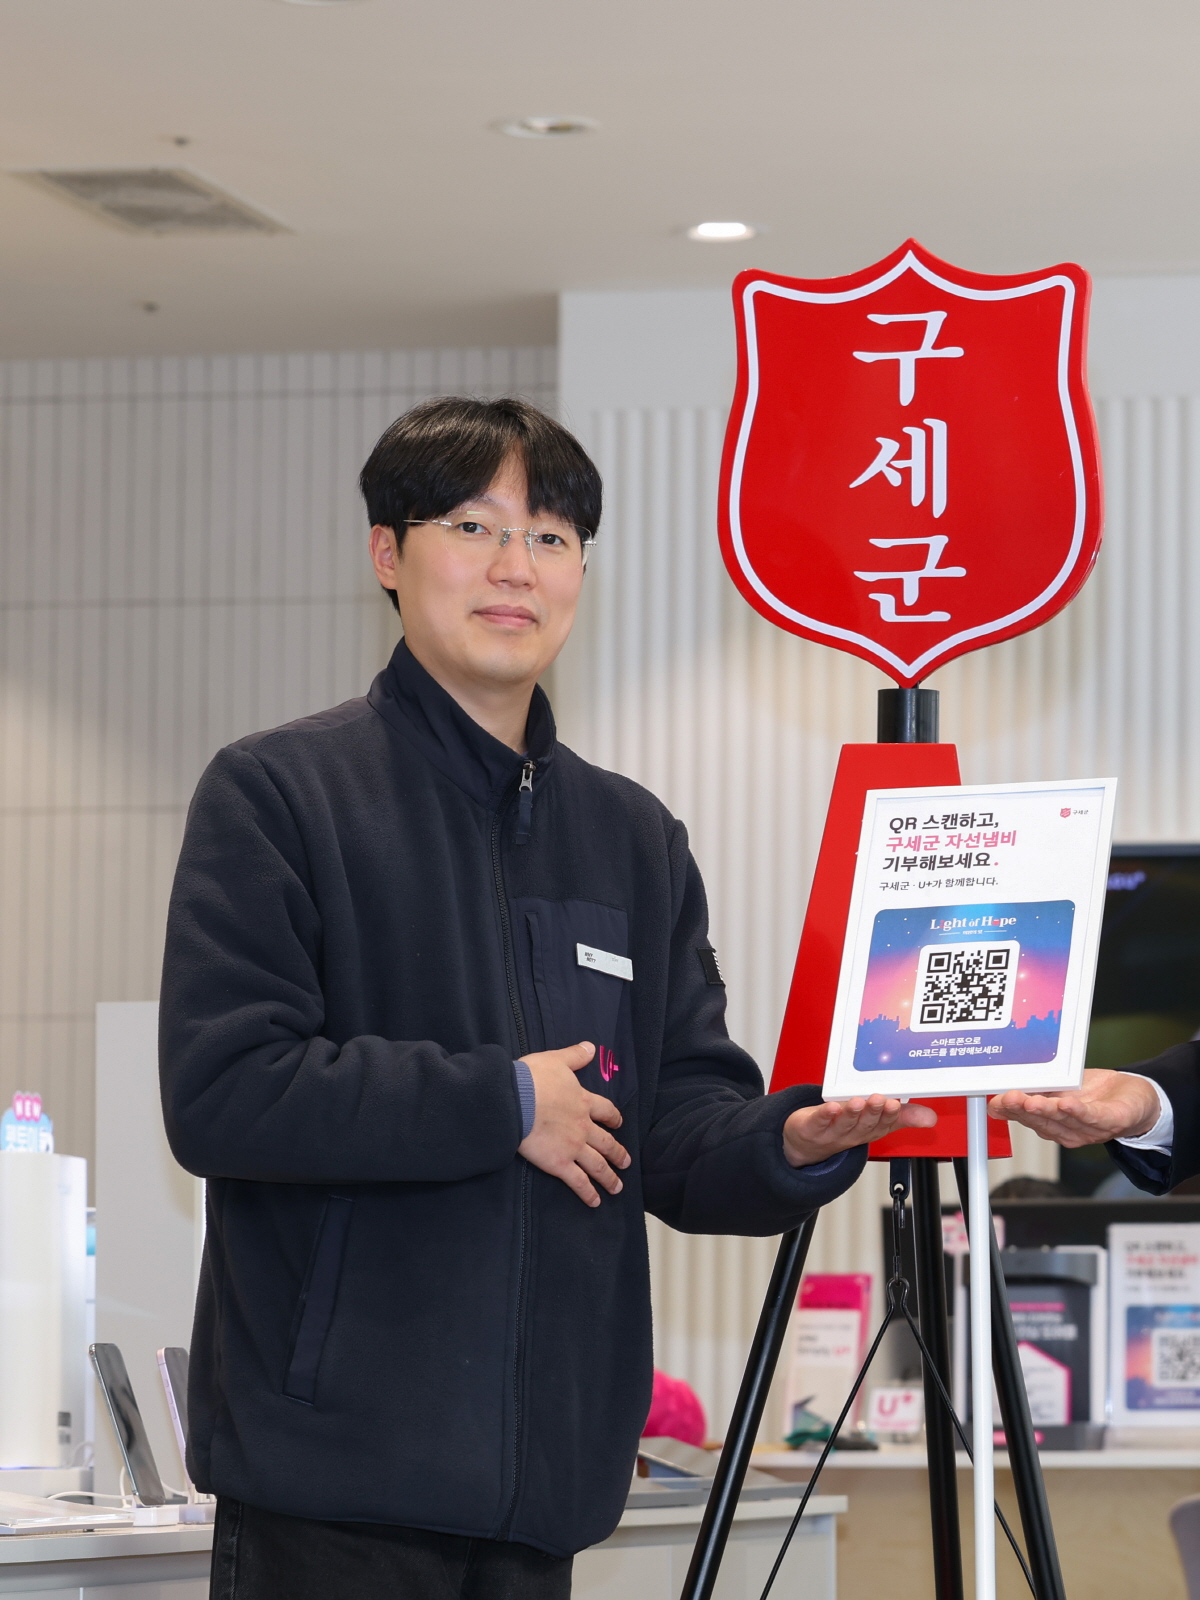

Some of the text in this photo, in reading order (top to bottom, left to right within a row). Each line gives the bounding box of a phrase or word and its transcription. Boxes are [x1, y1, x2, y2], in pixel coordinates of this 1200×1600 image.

[849, 310, 967, 622] 구세군
[889, 812, 999, 834] QR 스캔하고,
[885, 830, 1017, 853] 구세군 자선냄비
[879, 881, 910, 891] 구세군
[945, 877, 999, 888] 함께합니다.
[929, 918, 967, 931] Light
[968, 918, 980, 928] of
[930, 1037, 982, 1047] 스마트폰으로
[908, 1045, 1003, 1058] QR코드를 촬영해보세요!
